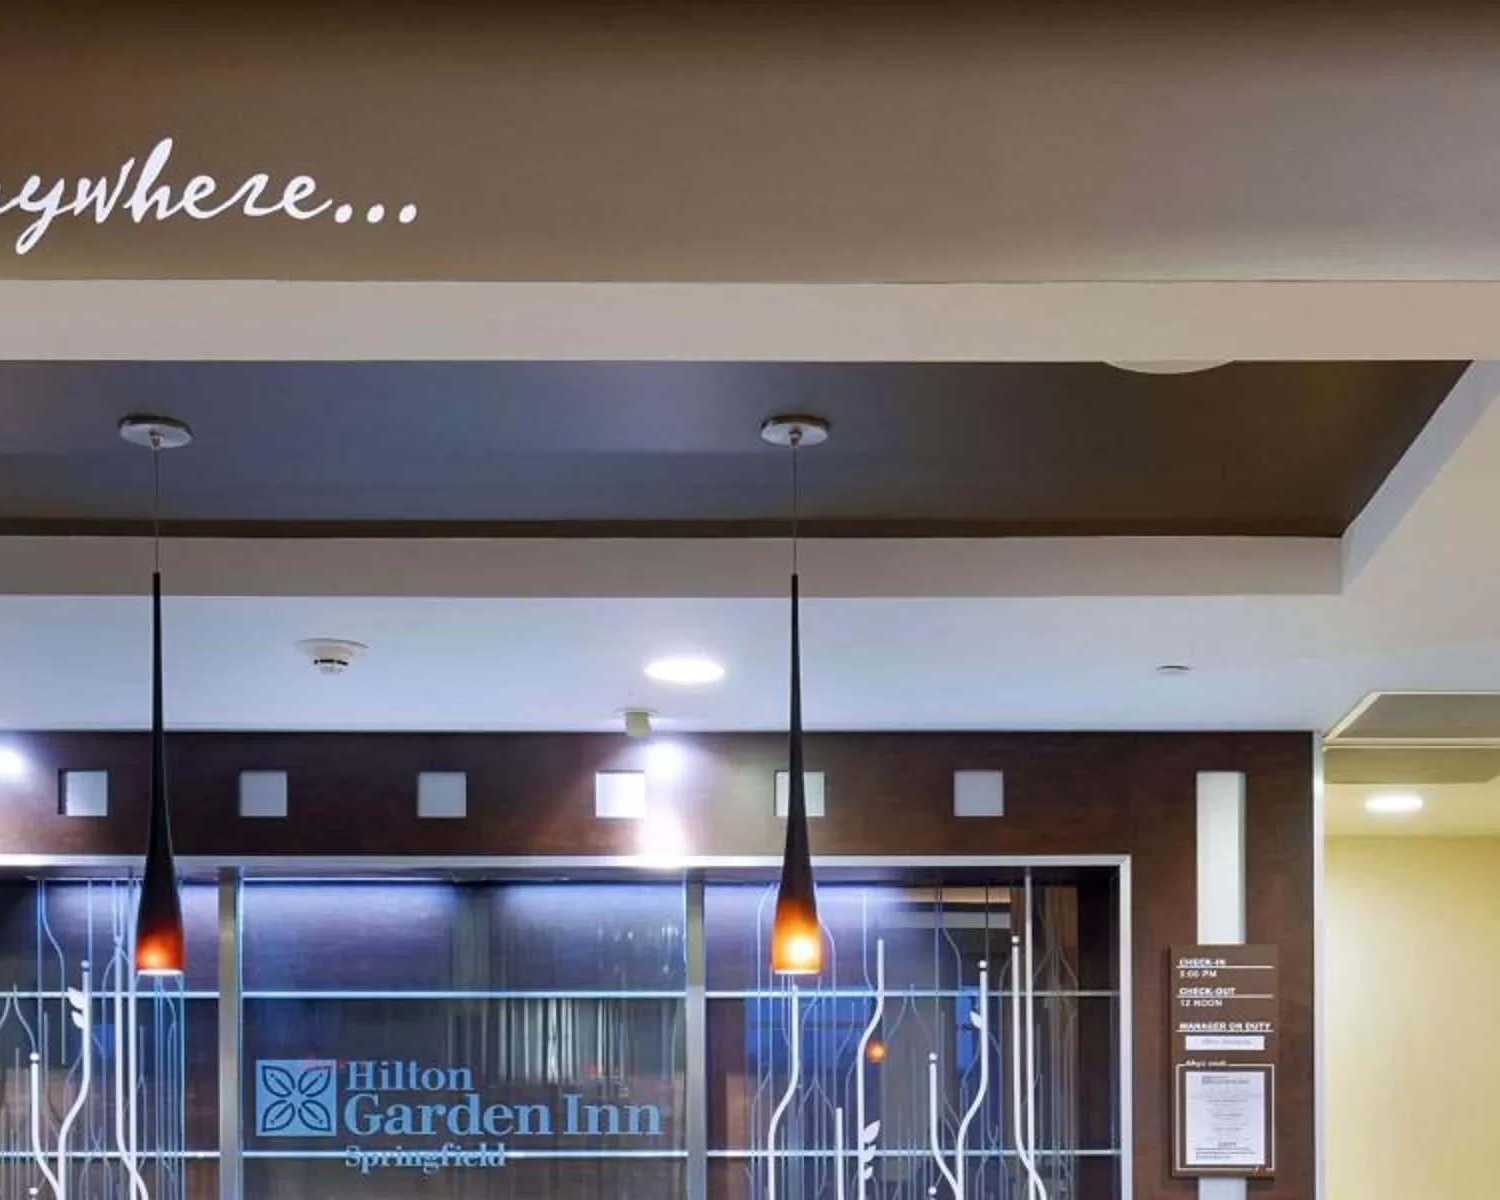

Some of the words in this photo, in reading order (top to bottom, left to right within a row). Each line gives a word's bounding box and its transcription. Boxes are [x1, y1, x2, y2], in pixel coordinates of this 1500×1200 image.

[1193, 999, 1223, 1008] NOON
[1244, 1021, 1272, 1031] DUTY
[346, 1060, 475, 1091] Hilton
[343, 1093, 554, 1137] Garden
[563, 1093, 663, 1137] Inn
[344, 1142, 507, 1175] Springfield
